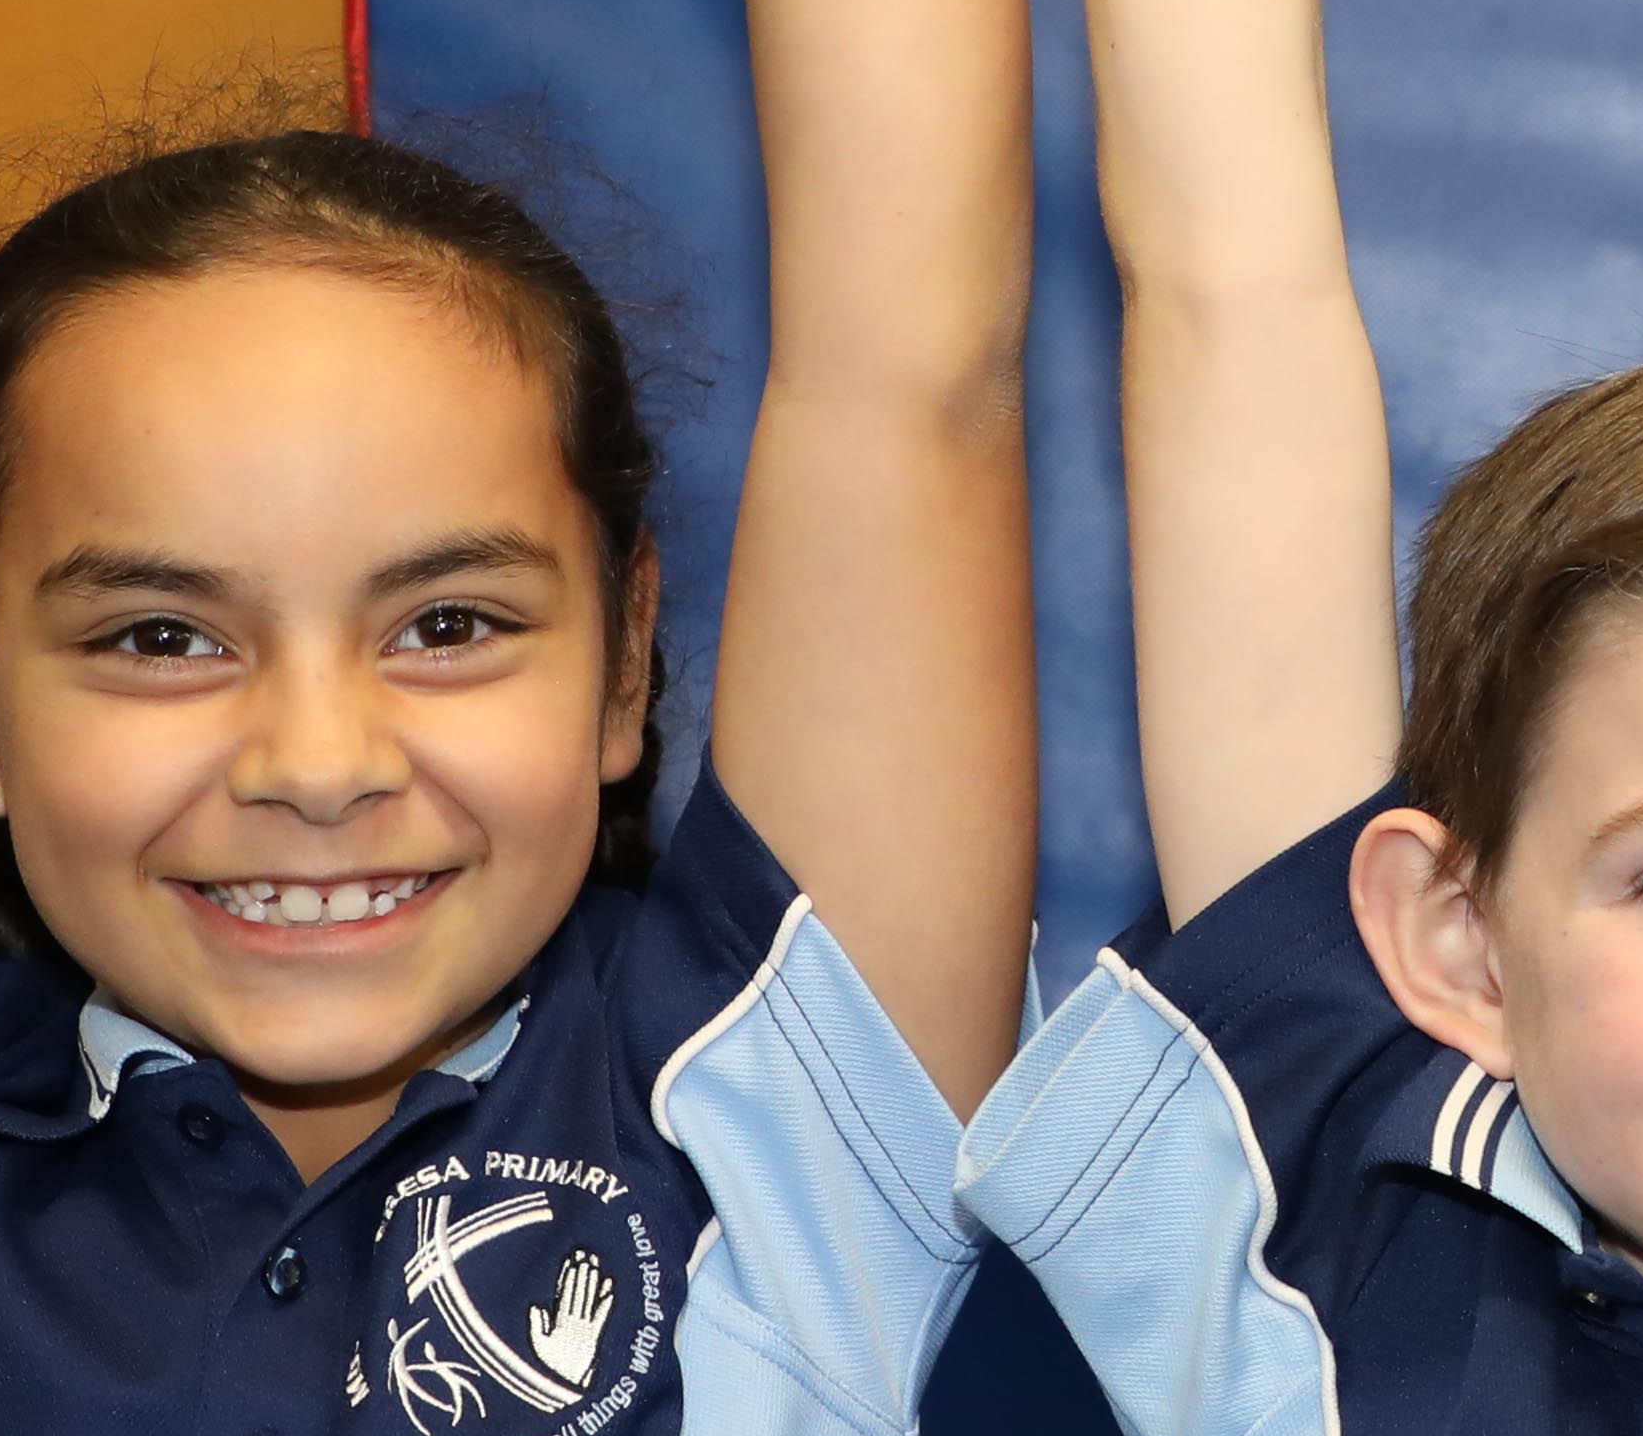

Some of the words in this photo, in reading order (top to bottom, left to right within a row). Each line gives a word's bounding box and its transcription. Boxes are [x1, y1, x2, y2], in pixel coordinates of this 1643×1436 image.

[485, 1150, 629, 1204] PRIMARY
[627, 1212, 656, 1257] love
[639, 1261, 664, 1322] great
[629, 1325, 660, 1374] with
[576, 1375, 637, 1436] things
